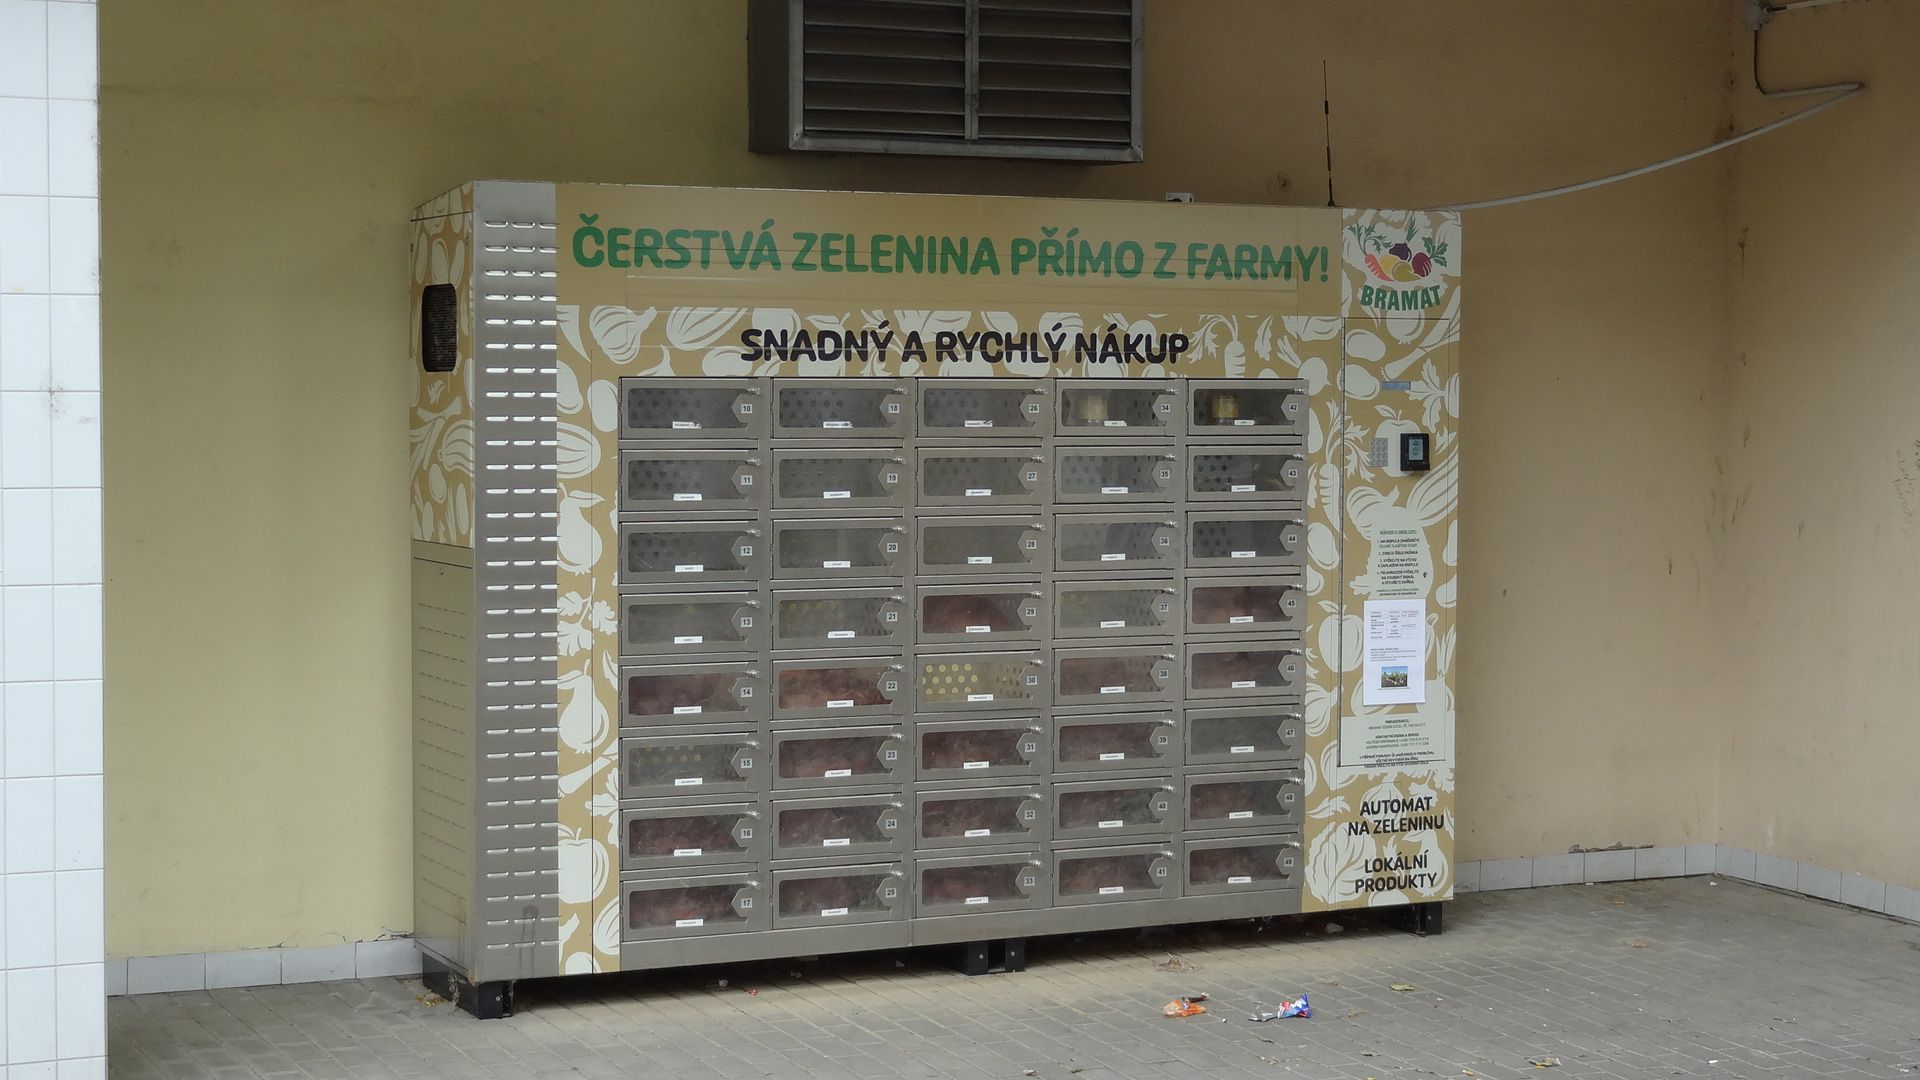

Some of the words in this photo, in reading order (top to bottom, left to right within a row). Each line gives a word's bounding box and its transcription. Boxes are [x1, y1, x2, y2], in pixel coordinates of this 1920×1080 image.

[572, 213, 782, 271] ČERSTVÁ
[791, 232, 1000, 275] ZELENINA
[1011, 227, 1144, 278] PŘÍMO
[1153, 242, 1177, 279] Z
[1187, 243, 1328, 282] FARMY!
[1360, 284, 1441, 310] BRAMAT
[741, 320, 893, 362] SNADNÝ
[902, 331, 927, 362] A
[936, 323, 1066, 363] RYCHLÝ
[1075, 323, 1189, 364] NÁKUP
[1360, 797, 1433, 816] AUTOMAT
[1349, 821, 1370, 836] NA
[1373, 815, 1444, 834] ZELENINU
[1365, 849, 1428, 873] LOKÁLNÍ
[1355, 872, 1437, 894] PRODUKTY
